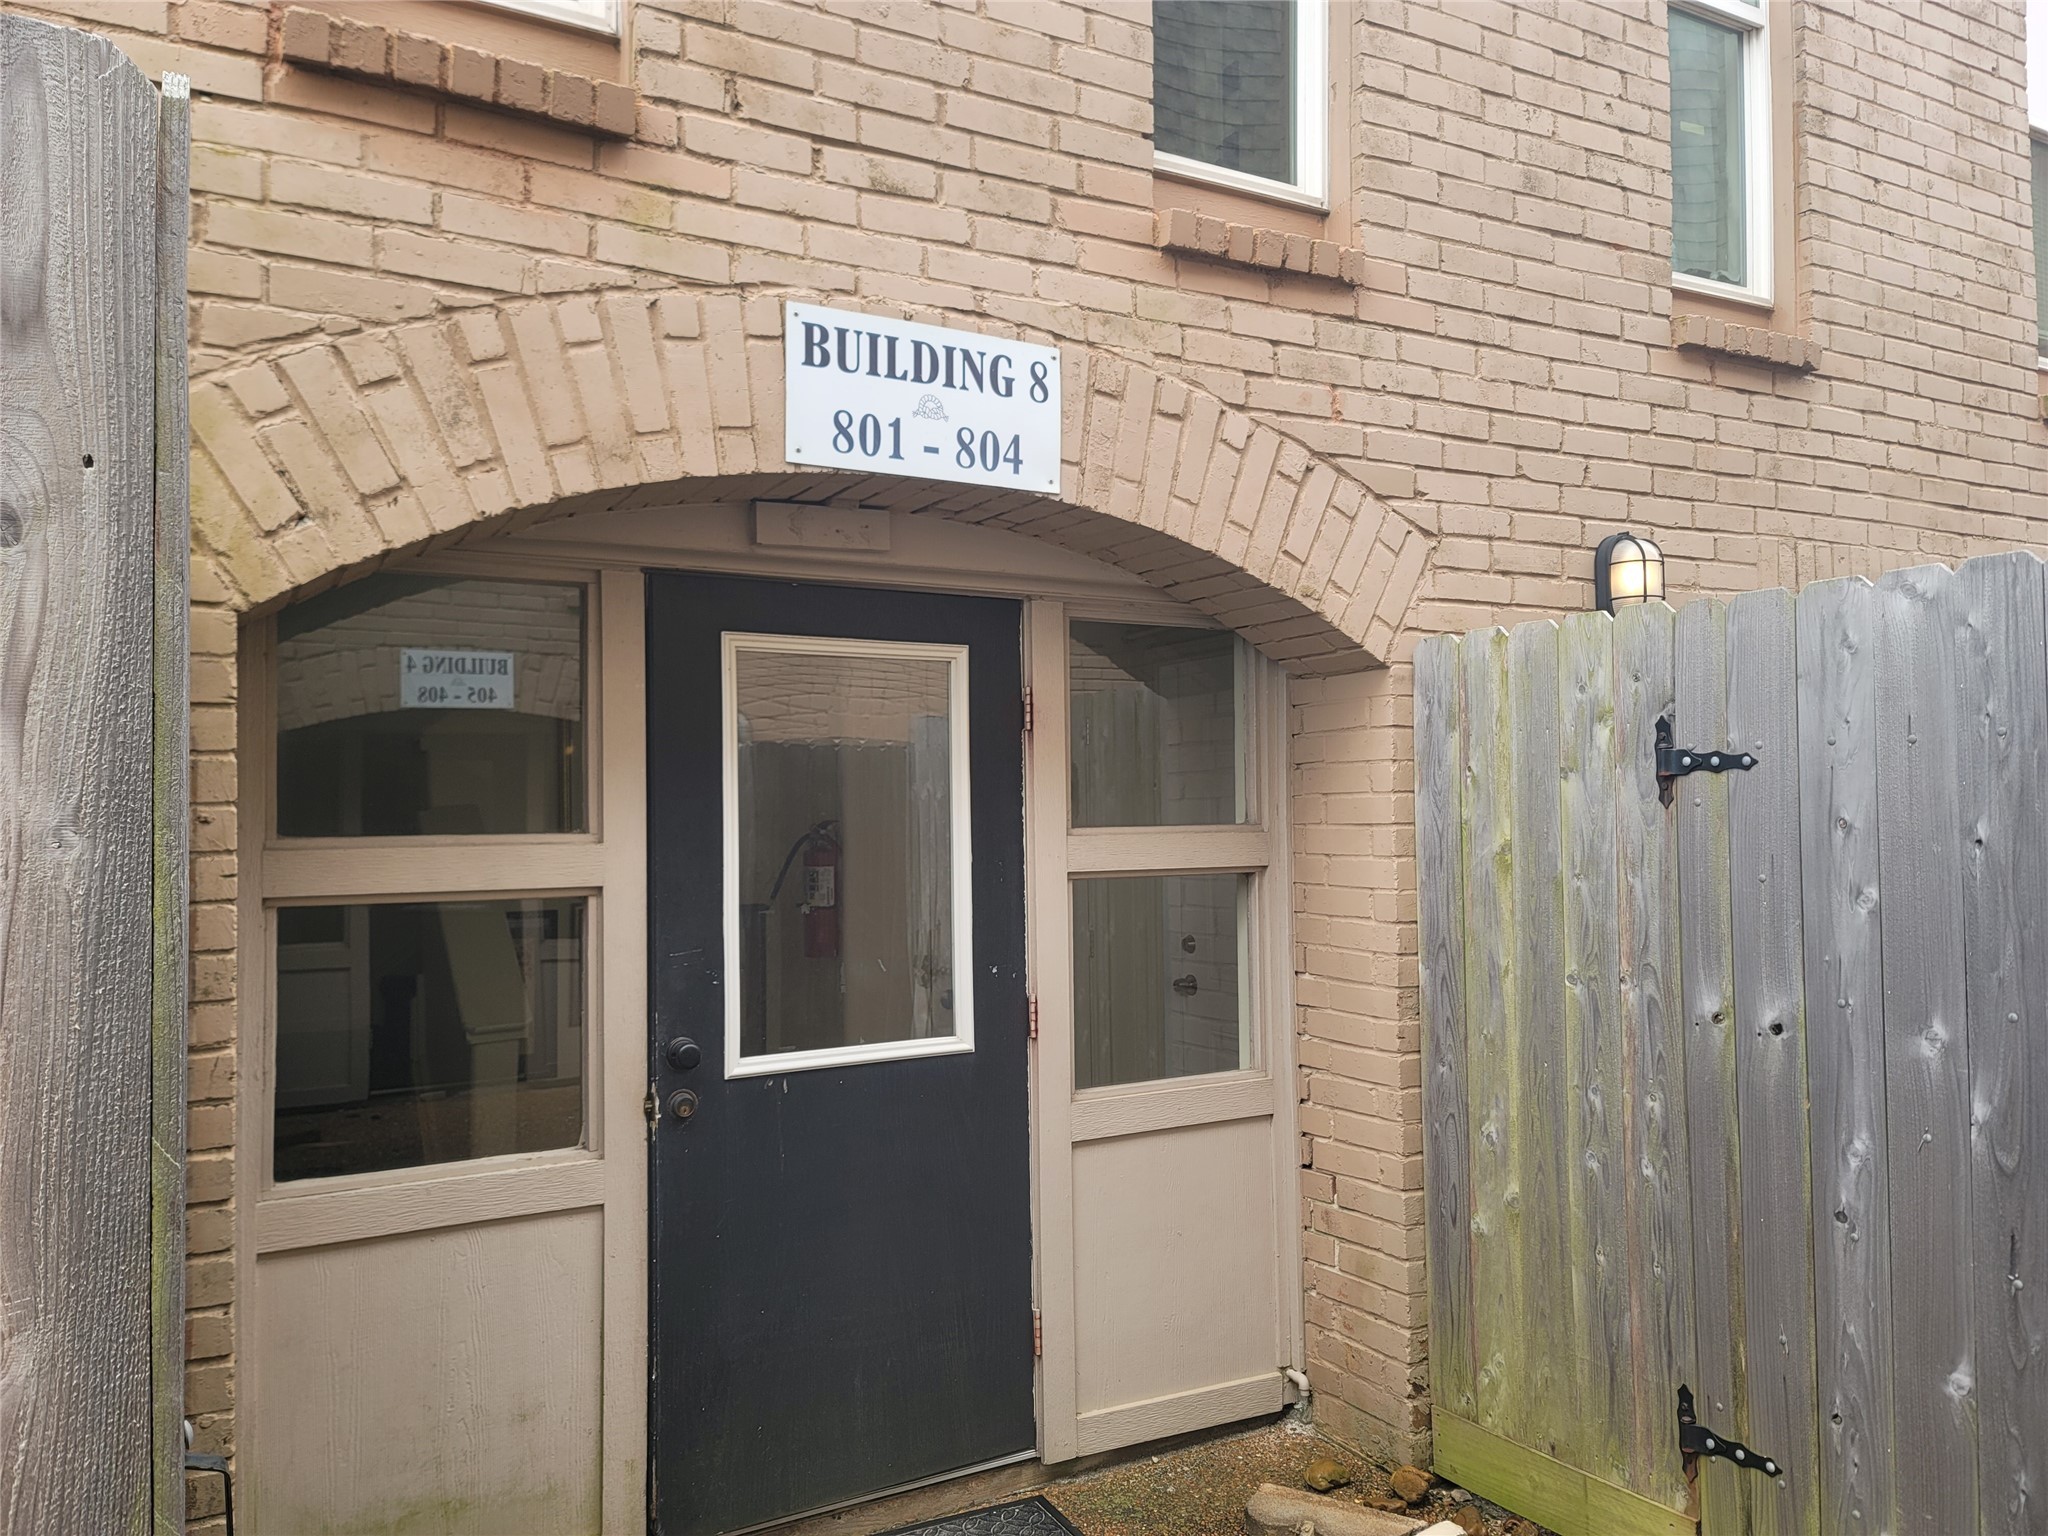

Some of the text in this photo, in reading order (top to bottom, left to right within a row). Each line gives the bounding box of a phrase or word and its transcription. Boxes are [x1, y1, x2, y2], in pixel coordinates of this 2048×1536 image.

[801, 321, 1049, 403] BUILDING 8
[832, 409, 1024, 475] 801 - 804
